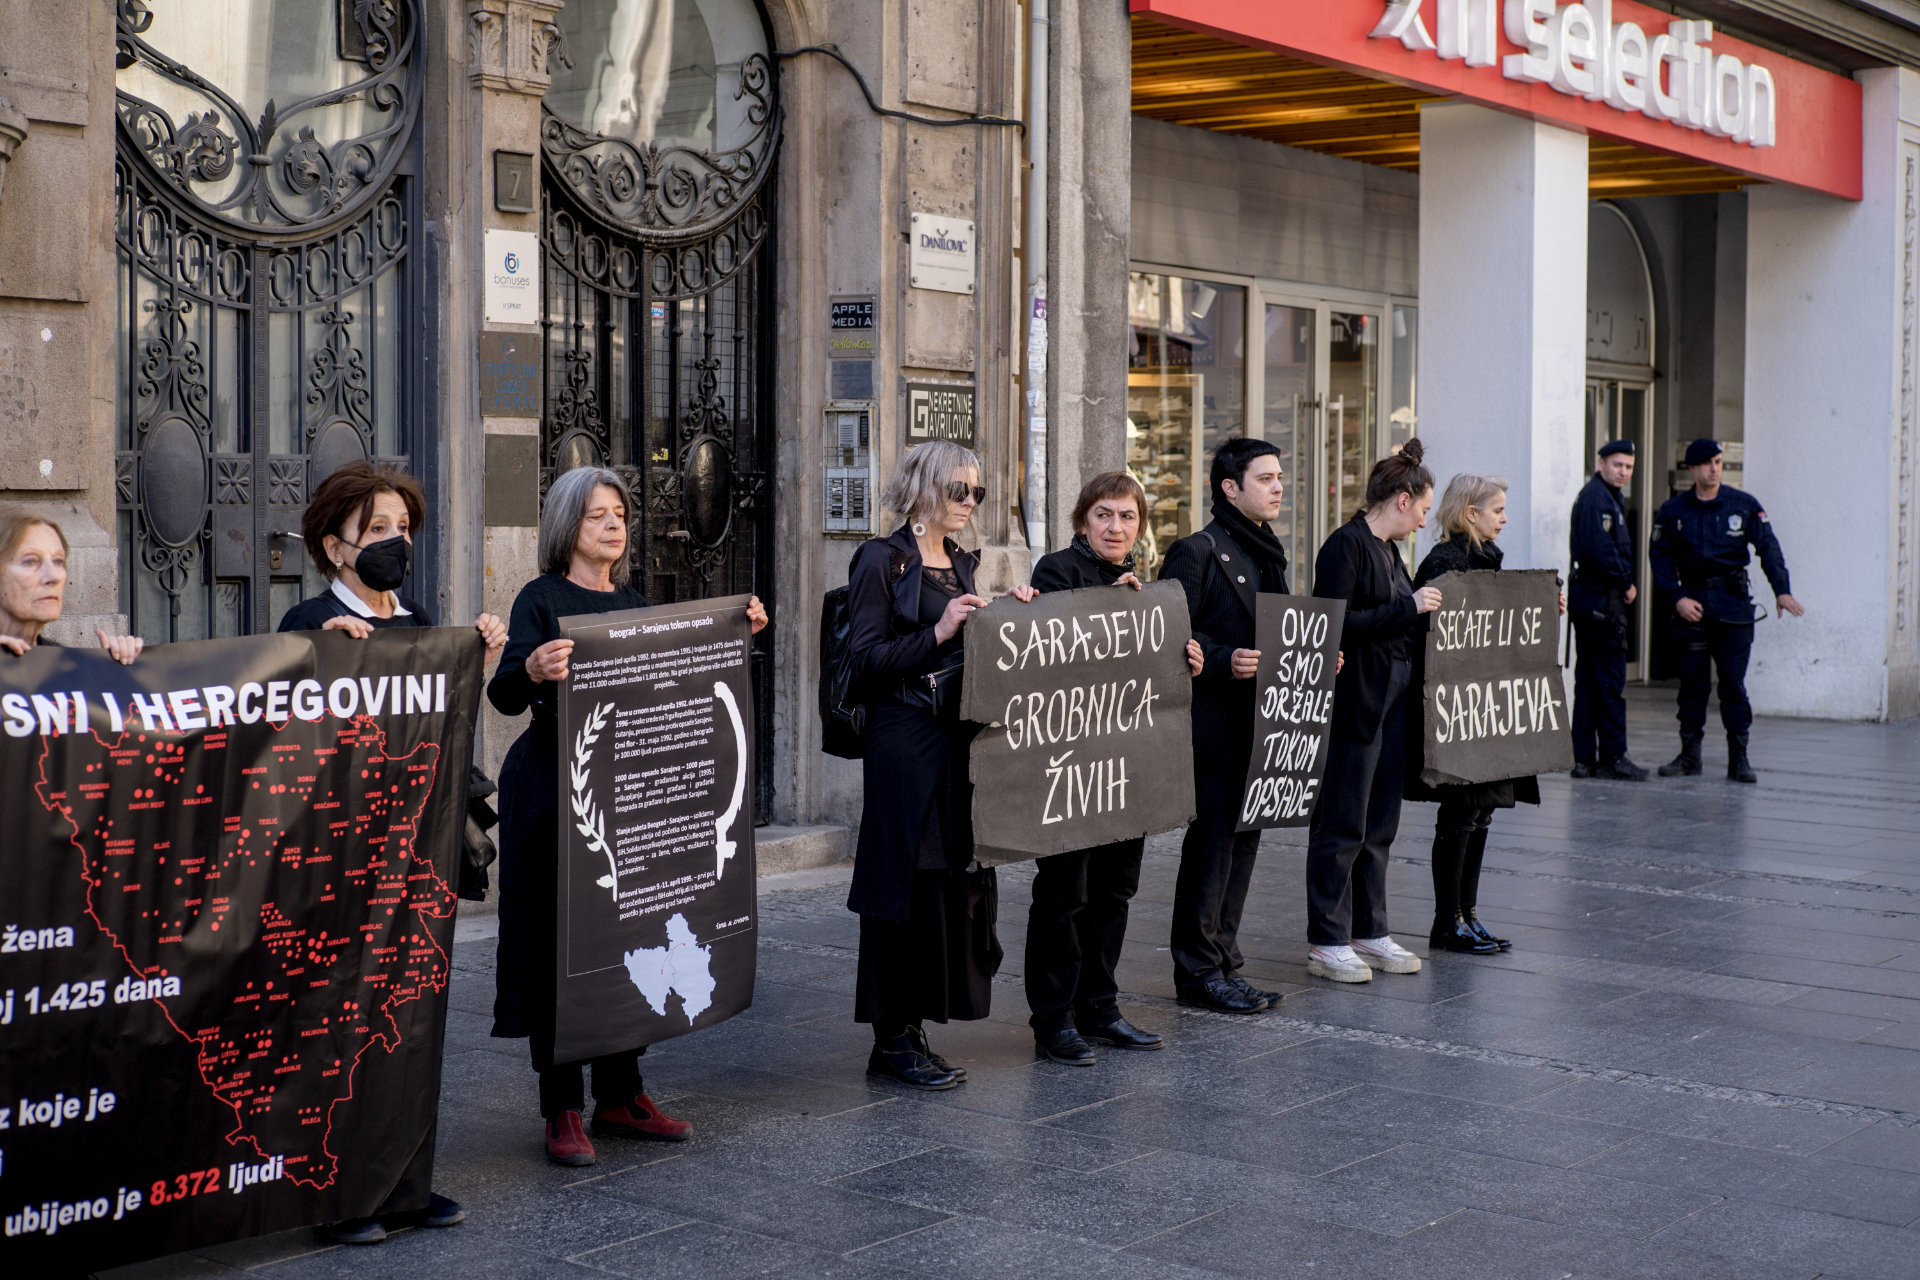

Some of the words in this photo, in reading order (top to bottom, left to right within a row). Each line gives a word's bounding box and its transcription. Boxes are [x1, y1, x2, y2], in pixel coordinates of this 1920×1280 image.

[1502, 0, 1775, 147] selection
[510, 170, 521, 200] 7
[494, 273, 530, 287] bonuses
[831, 317, 872, 327] MEDIA
[832, 304, 872, 314] APPLE
[929, 391, 972, 414] NEKRETNINE
[609, 626, 636, 638] Beograd
[670, 621, 690, 630] tokom
[691, 617, 713, 628] opsade
[997, 605, 1165, 672] SARAJEVO
[1281, 608, 1328, 647] OVO
[1436, 598, 1494, 651] SEĆATE
[1498, 608, 1514, 647] LI
[1520, 607, 1542, 645] SE
[1277, 650, 1324, 686] SMO
[102, 692, 124, 732] I
[132, 674, 446, 731] HERCEGOVINI
[1004, 678, 1160, 750] GROBNICA
[1260, 682, 1333, 724] DRŽALE
[1435, 676, 1562, 743] SARAJEVA
[1263, 729, 1321, 772] TOKOM
[615, 774, 627, 782] 1000
[1042, 750, 1130, 824] ŽIVIH
[1242, 775, 1319, 824] OPSADE
[2, 925, 74, 955] žena
[24, 979, 106, 1015] 1.425
[114, 976, 181, 1004] dana
[18, 1092, 81, 1128] koje
[85, 1088, 116, 1122] je
[4, 1196, 110, 1237] ubijeno
[113, 1187, 142, 1220] je
[150, 1167, 221, 1206] 8.372
[228, 1154, 285, 1193] ljudi
